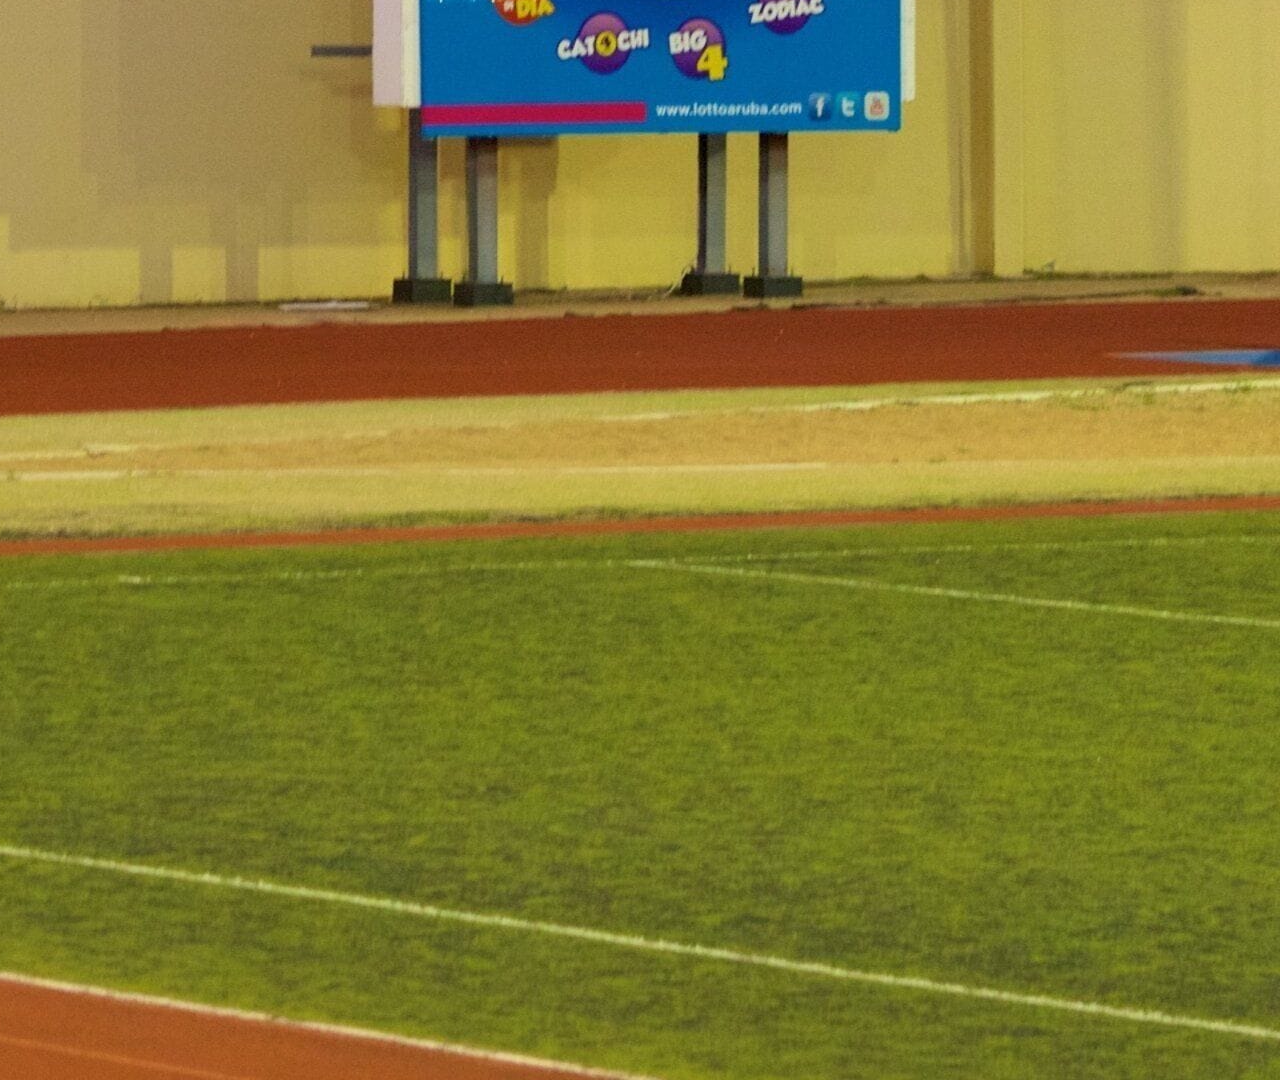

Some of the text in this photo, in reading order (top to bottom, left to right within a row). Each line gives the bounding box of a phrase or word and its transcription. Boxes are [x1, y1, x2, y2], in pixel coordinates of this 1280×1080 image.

[669, 29, 707, 54] BIG
[697, 43, 728, 81] 4
[656, 101, 802, 117] www.lottoaruba.com
